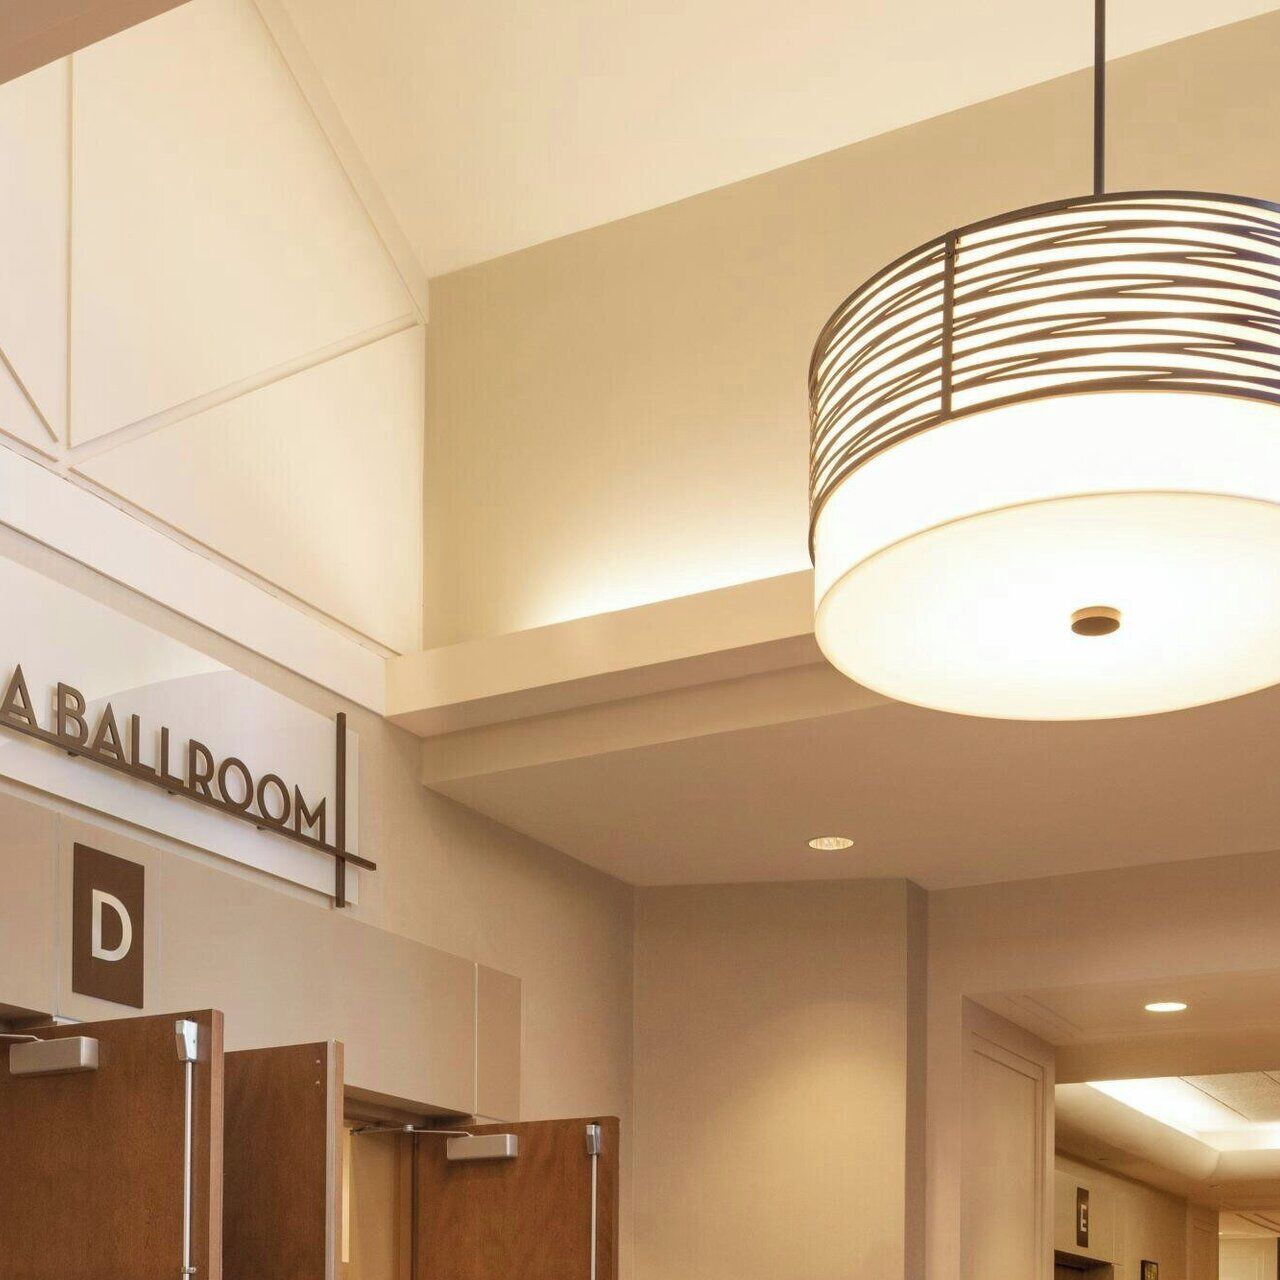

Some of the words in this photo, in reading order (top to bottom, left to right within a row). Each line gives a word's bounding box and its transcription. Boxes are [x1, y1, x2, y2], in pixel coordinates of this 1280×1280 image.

[57, 681, 327, 845] BALLROOM
[91, 888, 133, 962] D
[1080, 1203, 1088, 1233] E
